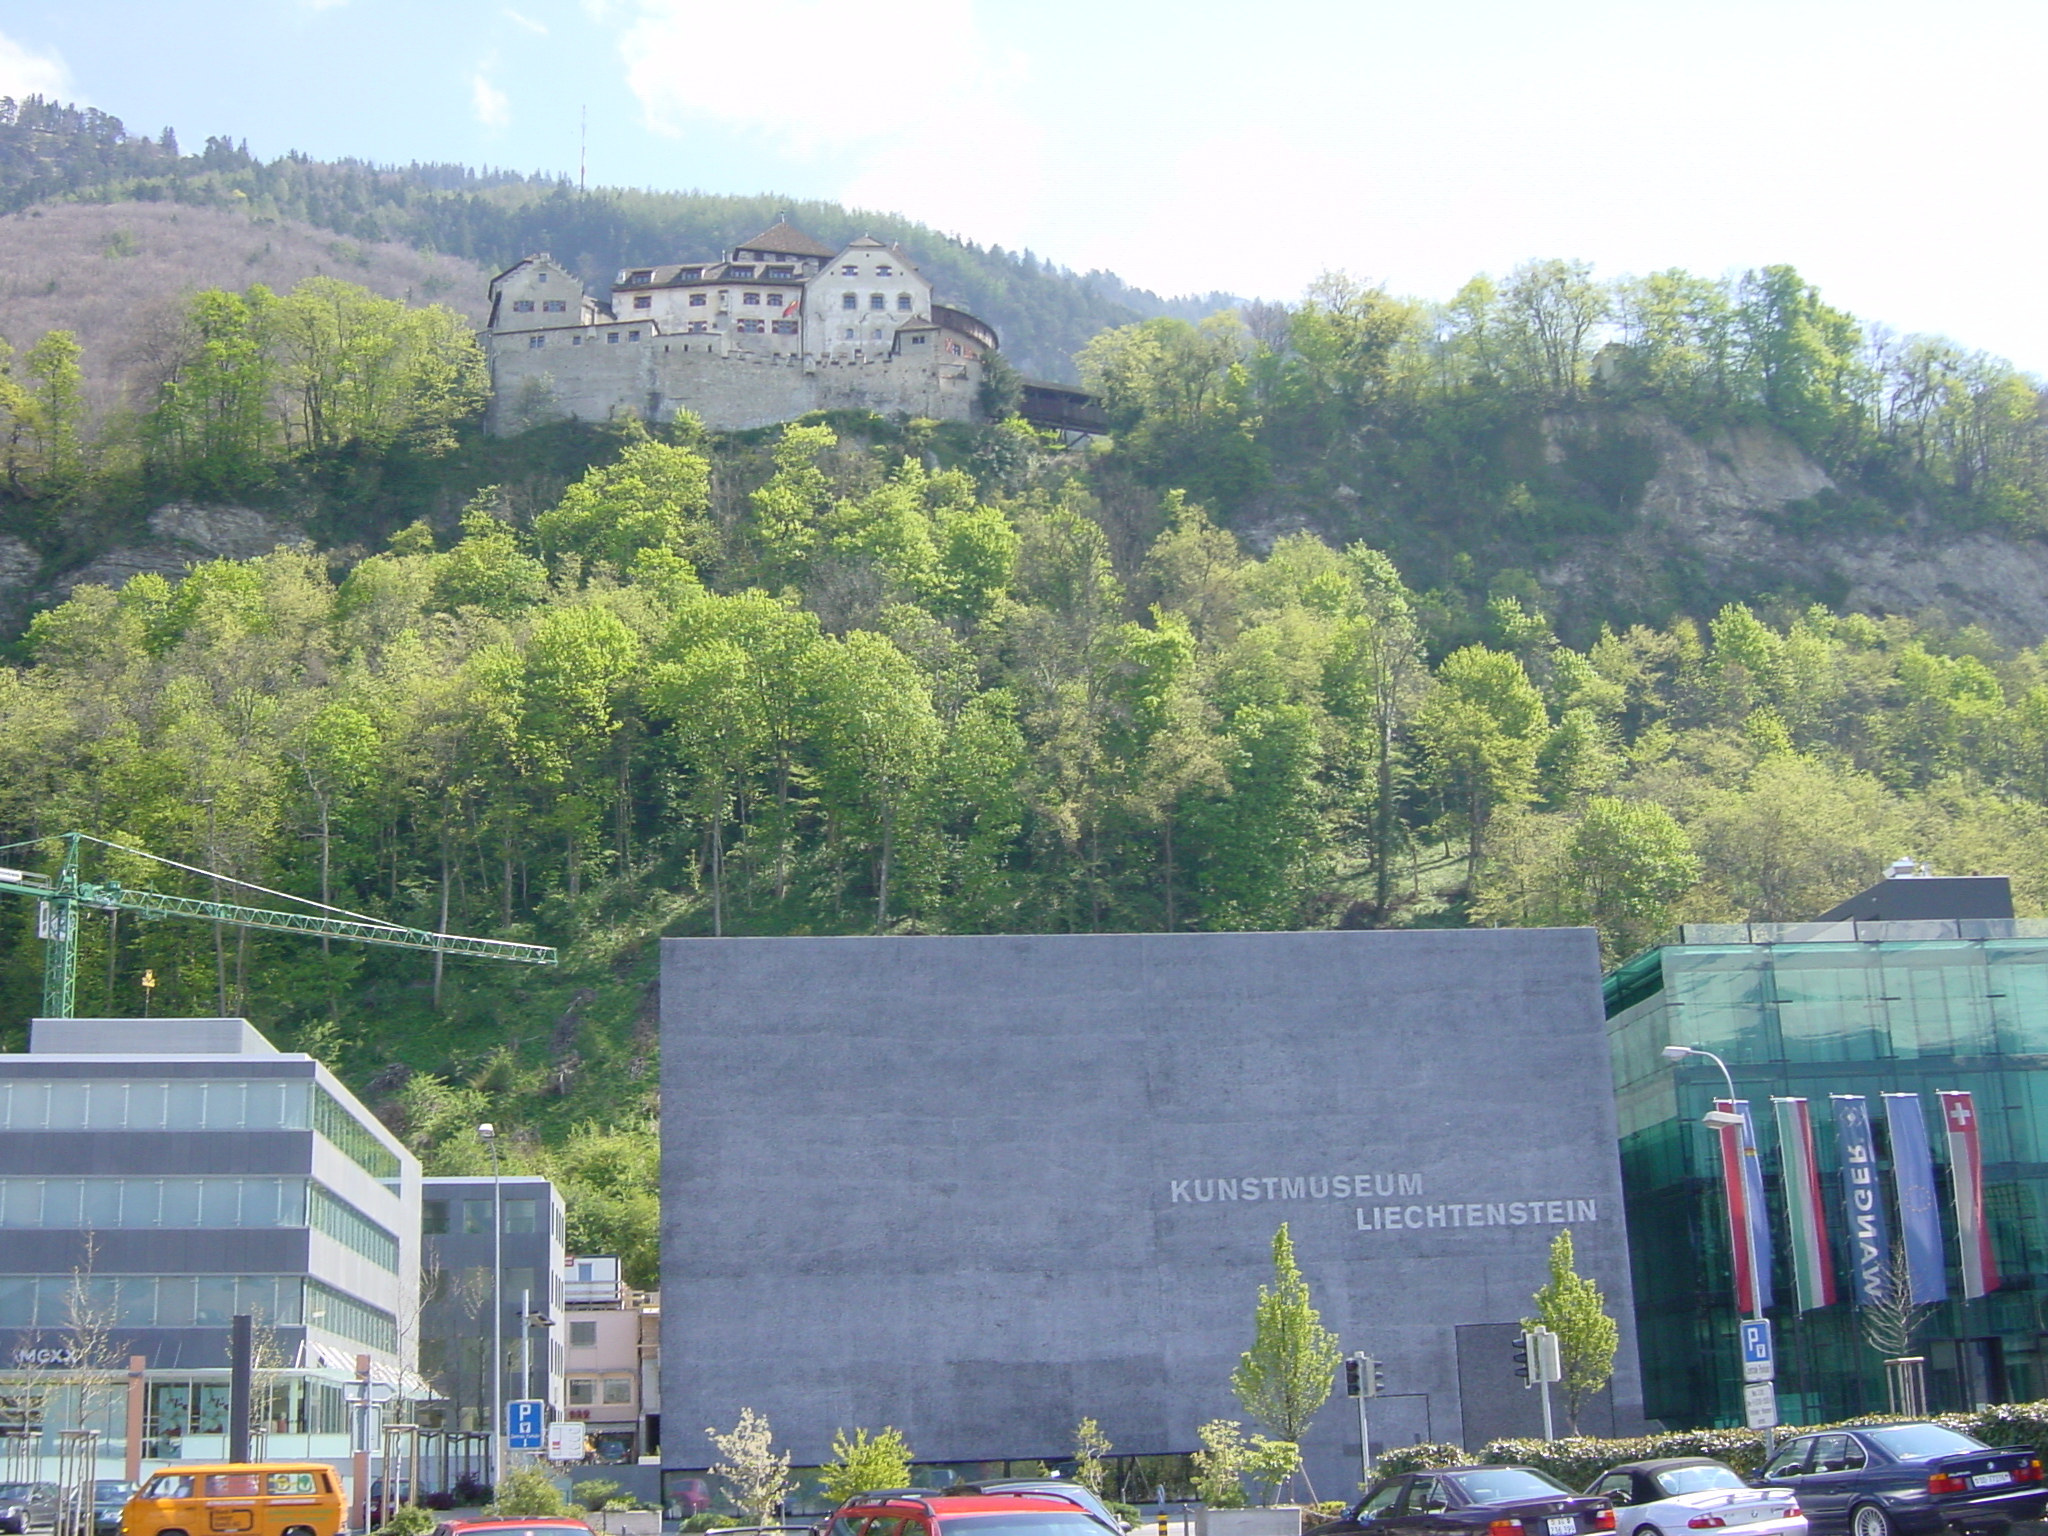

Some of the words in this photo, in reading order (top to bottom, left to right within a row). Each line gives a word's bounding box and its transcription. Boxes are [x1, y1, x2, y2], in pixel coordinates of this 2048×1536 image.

[1171, 1174, 1424, 1202] KUNSTMUSEUM
[1356, 1200, 1597, 1230] LIECHTENSTEIN
[1747, 1327, 1759, 1352] P
[519, 1404, 532, 1422] P
